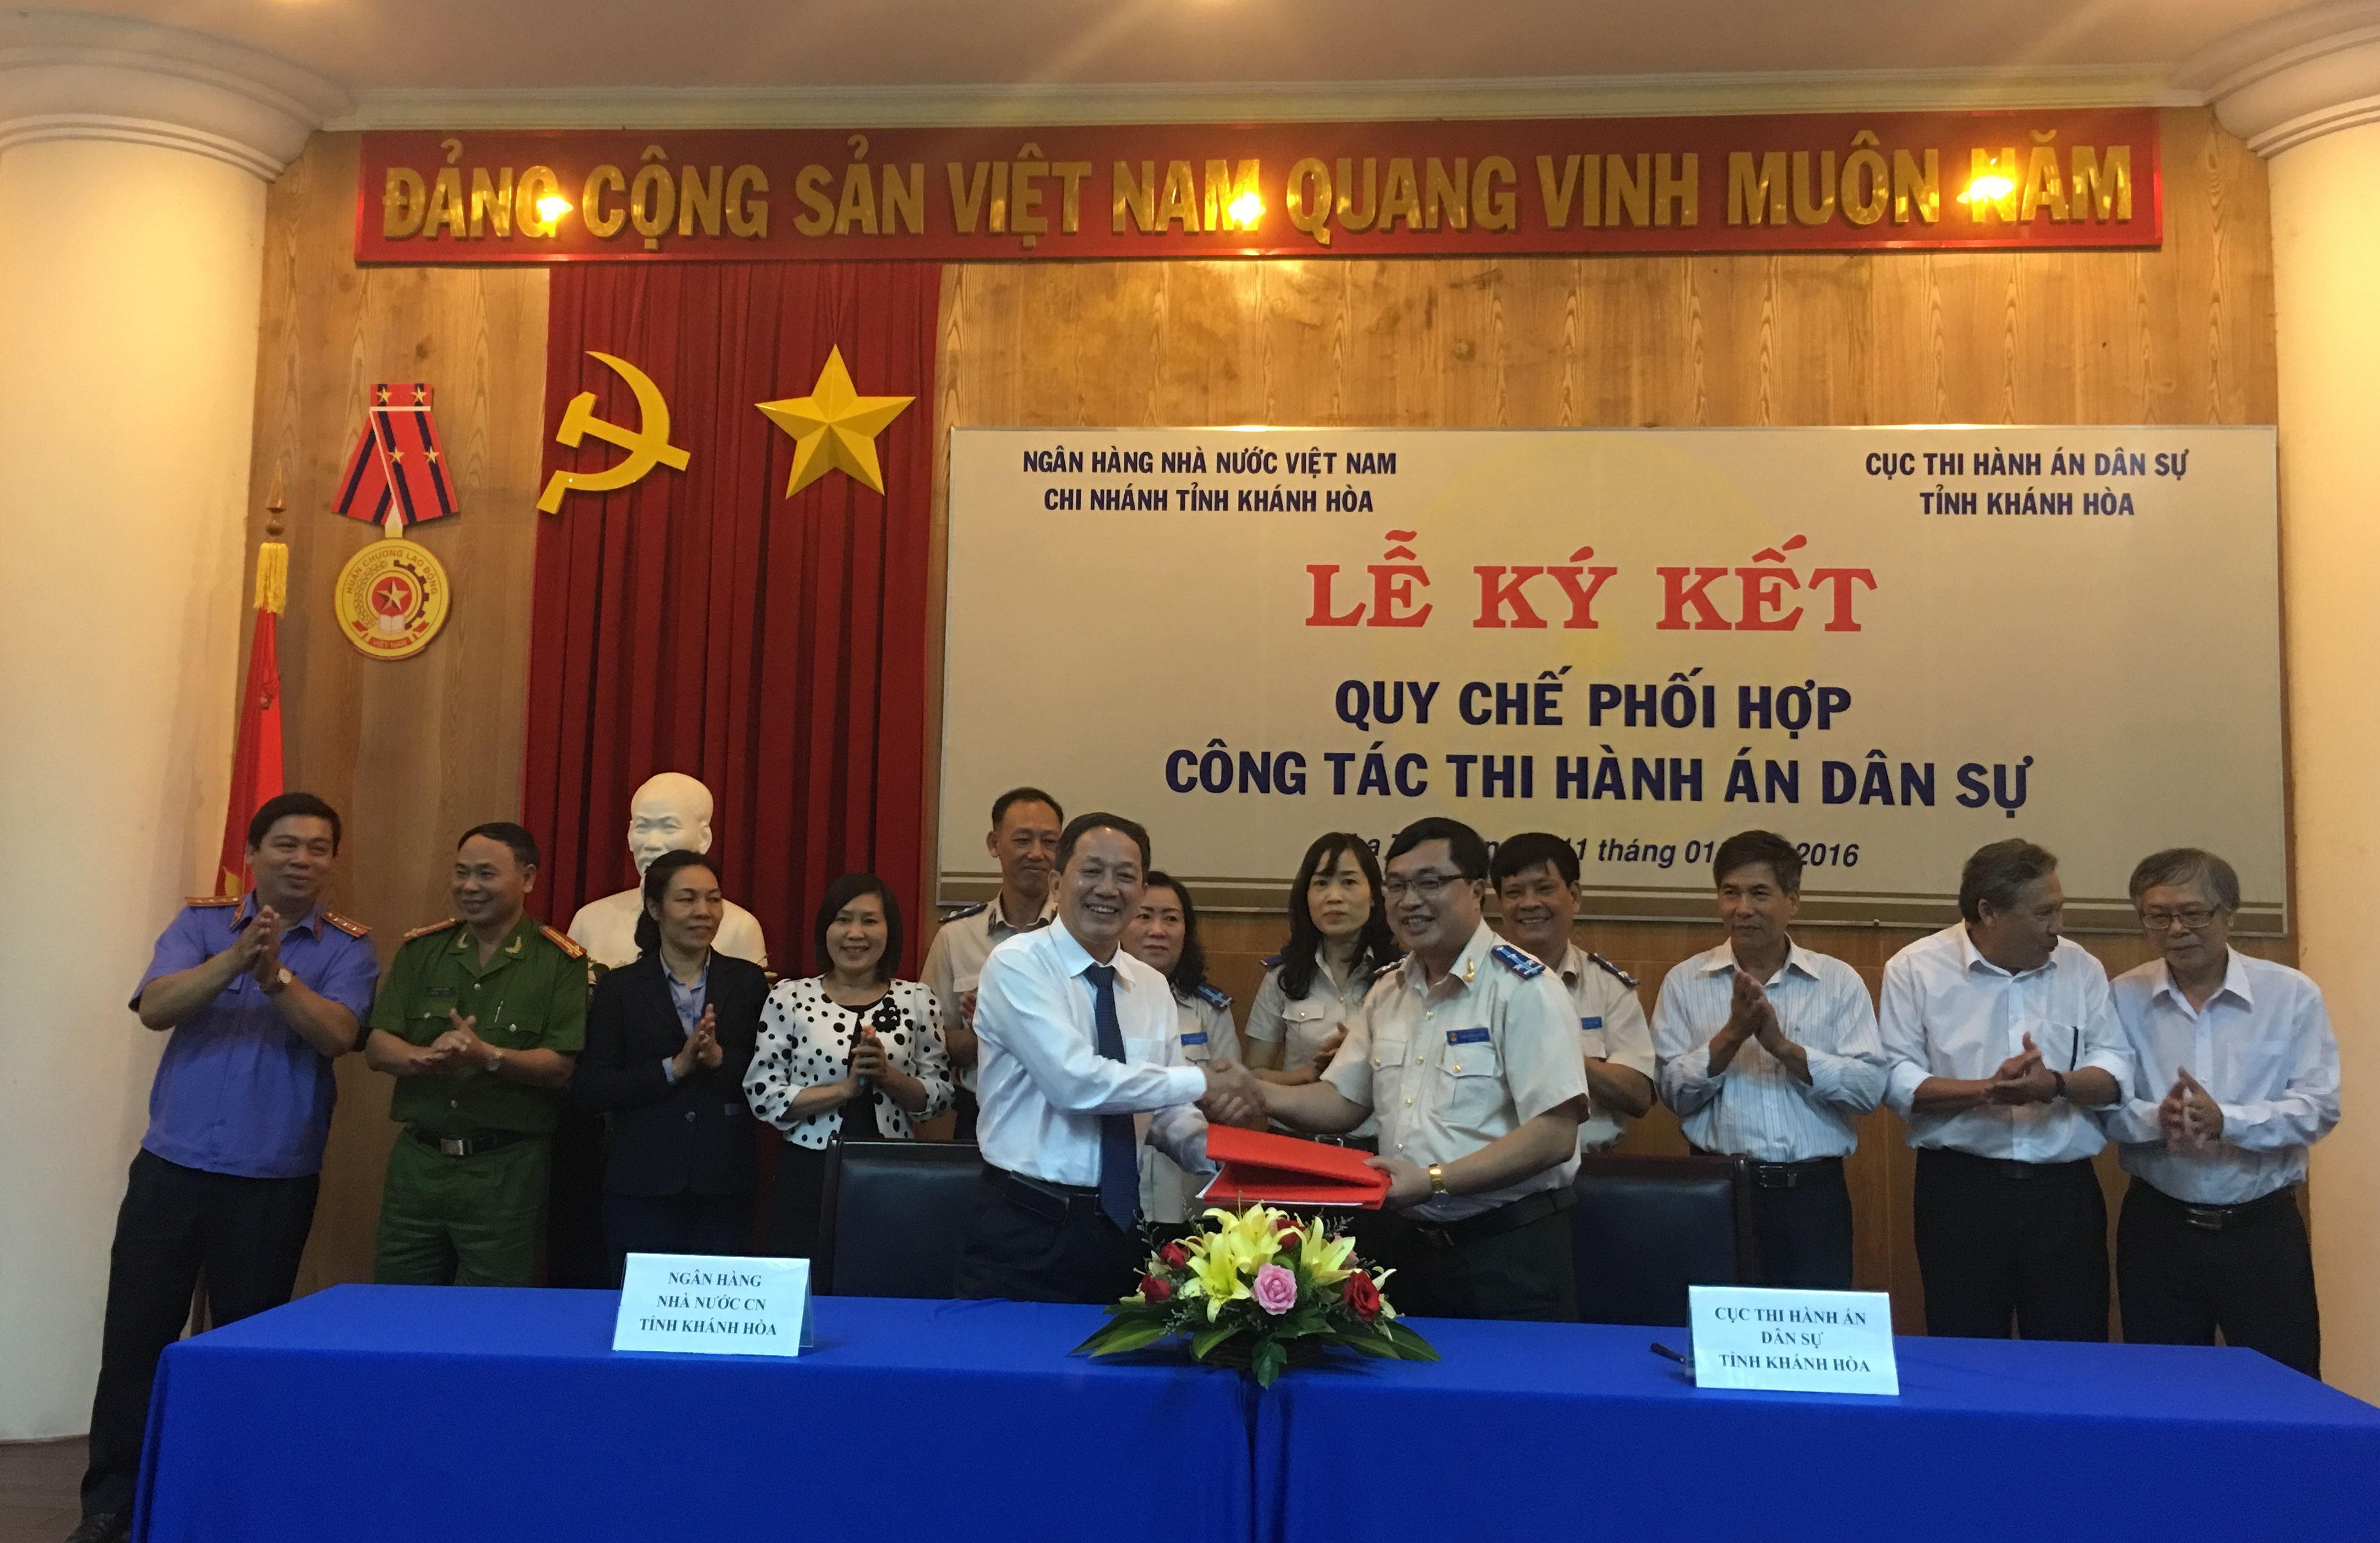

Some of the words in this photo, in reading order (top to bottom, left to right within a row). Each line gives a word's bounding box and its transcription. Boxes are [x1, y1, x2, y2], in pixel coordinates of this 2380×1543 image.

[382, 138, 558, 239] ĐẢNG
[582, 145, 769, 250] CỘNG
[794, 135, 925, 235] SẢN
[947, 142, 1091, 247] VIỆT
[1113, 159, 1261, 233] NAM
[1286, 157, 1516, 244] QUANG
[1536, 152, 1699, 228] VINH
[1728, 130, 1940, 226] MUÔN
[1971, 129, 2132, 222] NĂM
[1024, 446, 1083, 473] NGÂN
[1092, 446, 1153, 473] HÀNG
[1162, 446, 1206, 473] NHÀ
[1217, 447, 1277, 474] NƯỚC
[1286, 447, 1337, 479] VIỆT
[1347, 453, 1396, 474] NAM
[1866, 453, 1914, 480] CỤC
[1923, 453, 1963, 475] THI
[1974, 447, 2040, 475] HÀNH
[2051, 447, 2084, 475] ÁN
[2095, 447, 2145, 476] DÂN
[2155, 449, 2189, 480] SỰ
[1045, 488, 1081, 510] CHI
[1091, 484, 1167, 510] NHÁNH
[1176, 482, 1228, 511] TỈNH
[1238, 484, 1316, 512] KHÁNH
[1327, 485, 1373, 512] HÒA
[1920, 484, 1977, 515] TỈNH
[1988, 487, 2072, 515] KHÁNH
[2084, 487, 2134, 515] HÒA
[406, 552, 424, 567] LAO
[1306, 530, 1432, 627] LỄ
[1474, 547, 1617, 629] KÝ
[1657, 534, 1877, 632] KẾT
[390, 640, 408, 648] NAM
[1336, 680, 1439, 731] QUY
[1459, 665, 1573, 727] CHẾ
[1589, 668, 1715, 728] PHỐI
[1739, 679, 1851, 739] HỢP
[1166, 739, 1306, 795] CÔNG
[1324, 741, 1427, 797] TÁC
[1446, 755, 1532, 798] THI
[1556, 745, 1702, 801] HÀNH
[1725, 747, 1799, 803] ÁN
[1822, 749, 1934, 806] DÂN
[1956, 755, 2034, 818] SỰ
[1598, 837, 1675, 869] tháng
[1685, 840, 1714, 864] 01
[1797, 842, 1859, 867] 2016
[668, 1269, 712, 1285] NGÂN
[717, 1270, 762, 1287] HÀNG
[657, 1292, 690, 1309] NHÀ
[695, 1294, 740, 1310] NƯỚC
[744, 1298, 766, 1311] CN
[1715, 1307, 1750, 1324] CỤC
[1755, 1308, 1784, 1322] THI
[1789, 1306, 1838, 1324] HÀNH
[1843, 1308, 1866, 1325] ÁN
[640, 1315, 677, 1332] TỈNH
[681, 1317, 739, 1334] KHÁNH
[743, 1320, 777, 1336] HÒA
[1761, 1328, 1796, 1345] DÂN
[1801, 1331, 1824, 1349] SỰ
[1719, 1351, 1761, 1369] TỈNH
[1766, 1353, 1828, 1371] KHÁNH
[1833, 1355, 1871, 1373] HÒA
